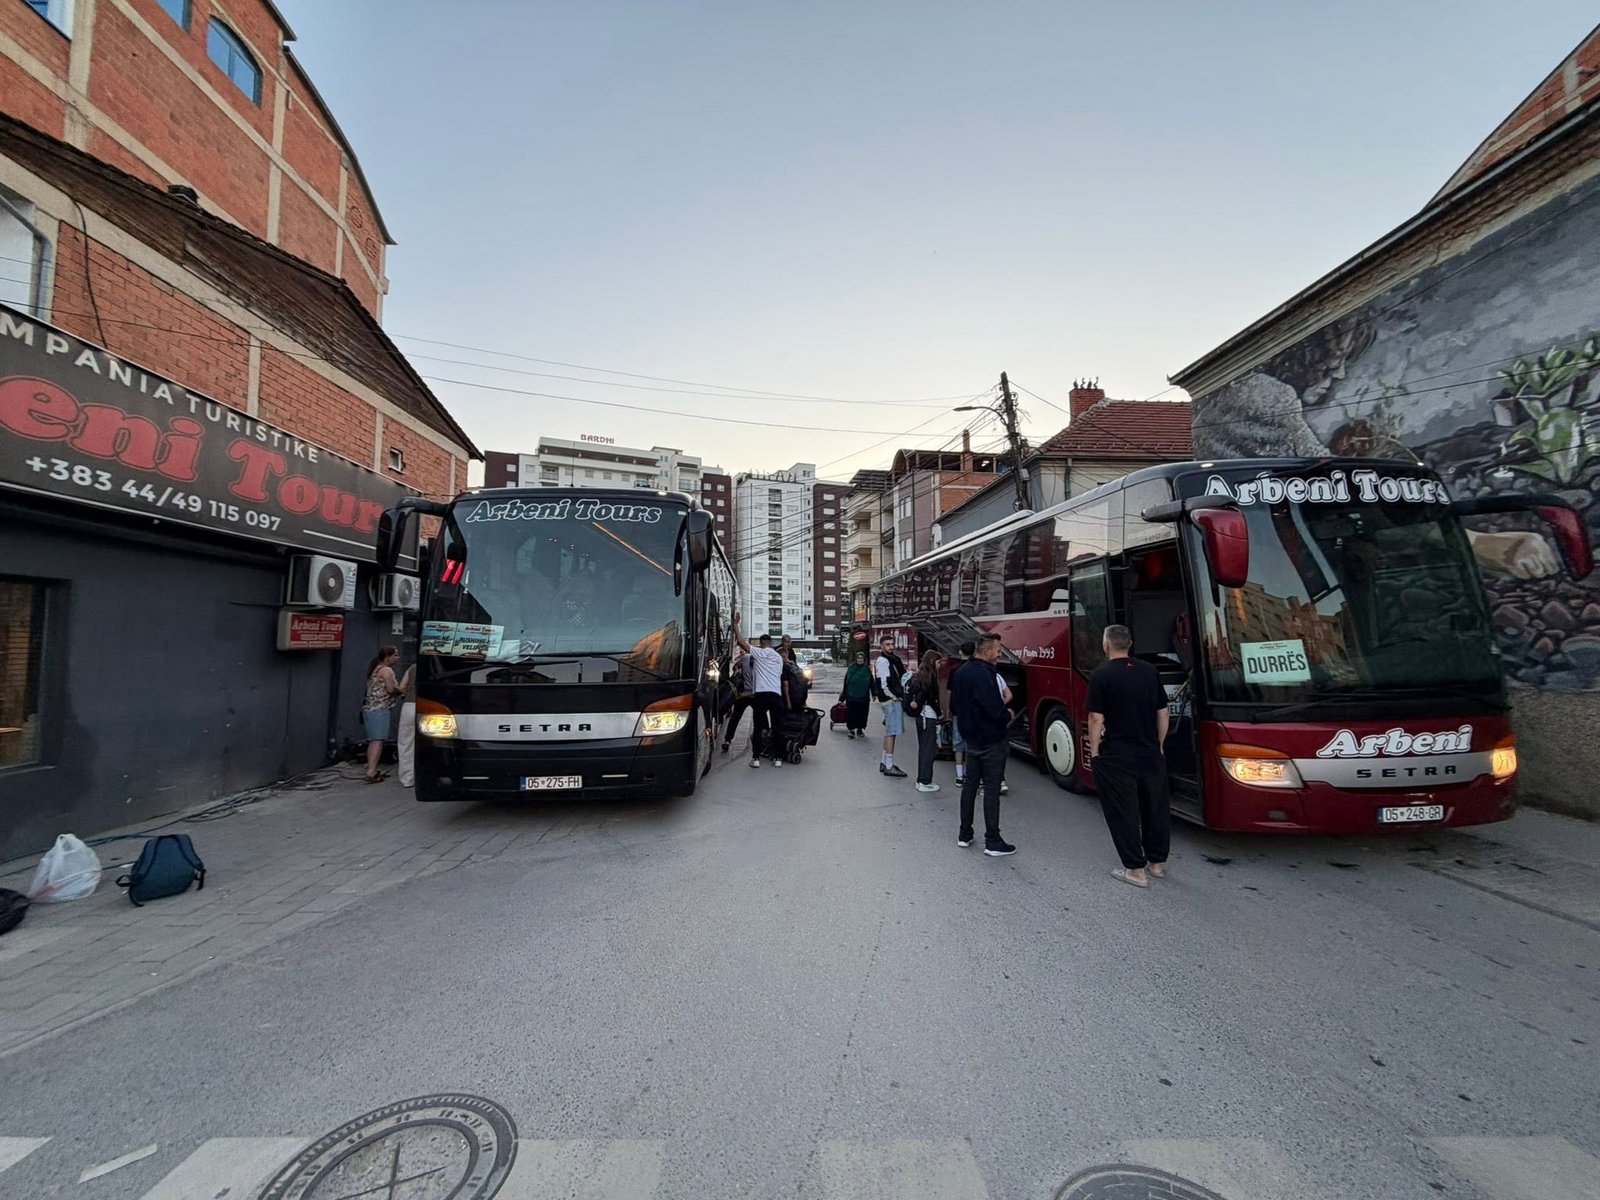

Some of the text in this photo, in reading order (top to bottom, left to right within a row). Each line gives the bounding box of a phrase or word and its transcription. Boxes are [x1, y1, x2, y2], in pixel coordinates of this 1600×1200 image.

[186, 393, 319, 463] TURISTIKE
[580, 433, 615, 445] BARDHI
[26, 456, 281, 531] +383 44/49 115 097
[1204, 469, 1451, 505] Arbeni Tours
[466, 498, 662, 523] Arbeni Tours
[1247, 651, 1306, 674] DURRËS
[498, 723, 592, 732] SETRA
[1316, 724, 1473, 759] Arbeni
[1356, 765, 1457, 778] SETRA
